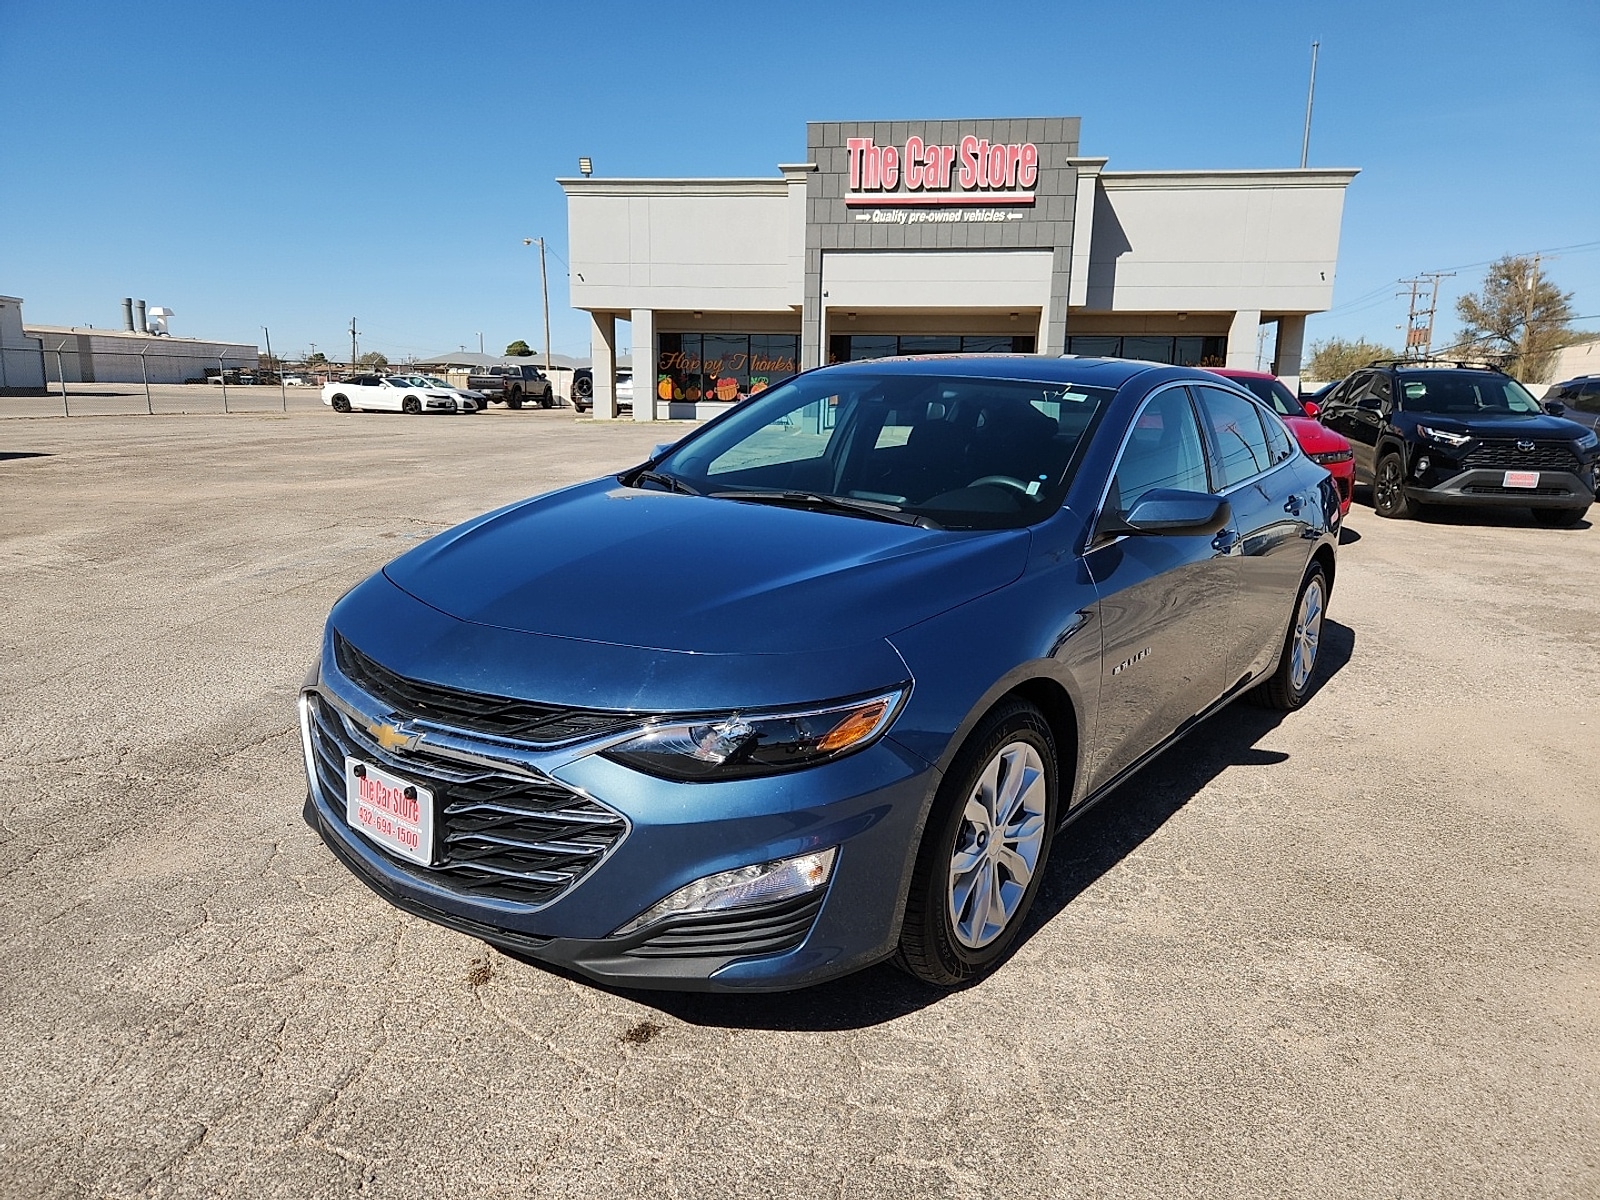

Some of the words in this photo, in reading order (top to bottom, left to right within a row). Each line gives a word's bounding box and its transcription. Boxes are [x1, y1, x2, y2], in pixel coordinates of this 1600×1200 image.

[847, 138, 899, 189] The
[905, 136, 955, 190] Car
[959, 135, 1038, 189] Store
[872, 209, 907, 224] Quality
[908, 209, 962, 225] pre-owned
[963, 208, 1006, 222] vehicles
[660, 352, 725, 375] Happy
[359, 775, 373, 800] The
[375, 780, 391, 808] Car
[394, 788, 419, 822] Store
